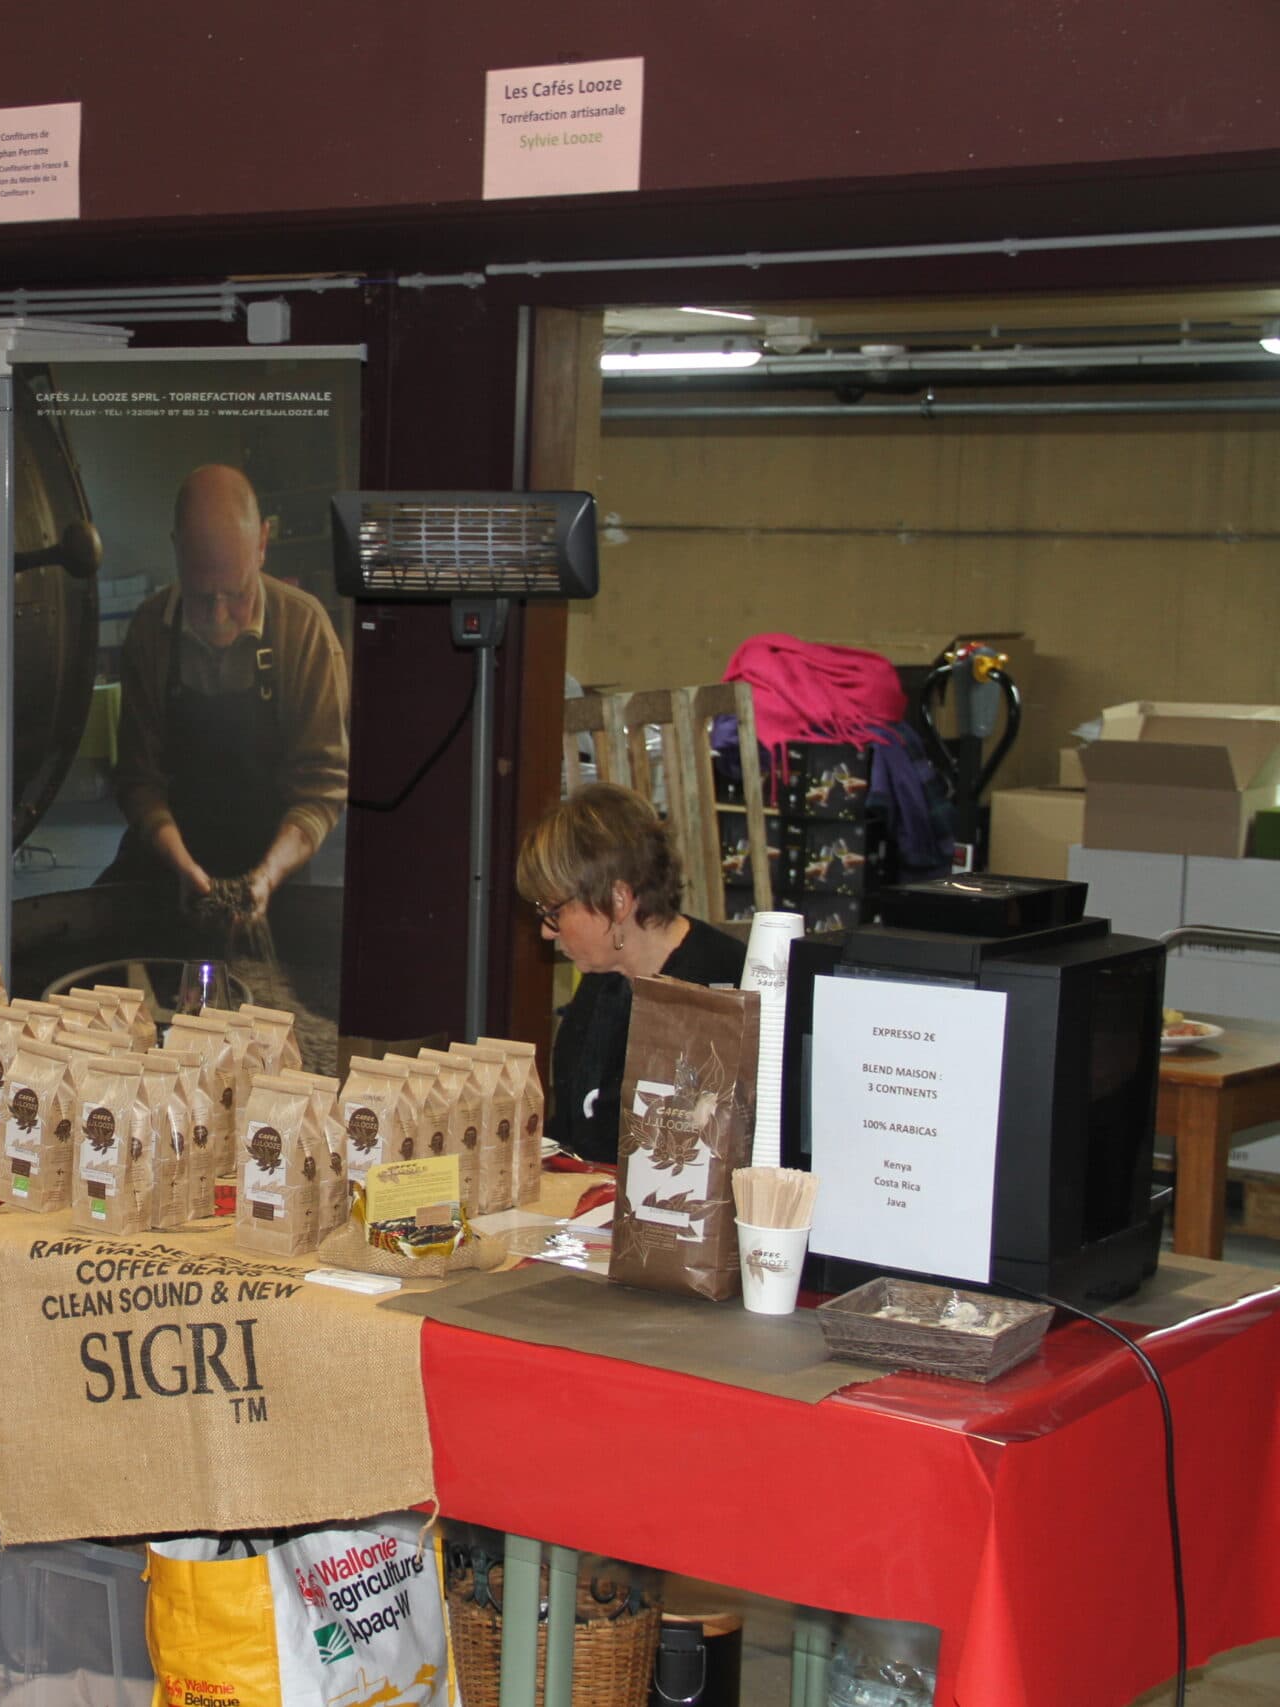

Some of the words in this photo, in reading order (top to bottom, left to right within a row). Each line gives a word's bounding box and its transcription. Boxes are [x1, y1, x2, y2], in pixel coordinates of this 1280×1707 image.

[504, 84, 528, 100] Les
[532, 80, 574, 98] Cafés
[579, 78, 623, 94] Looze
[500, 109, 568, 125] Torréfaction
[570, 103, 626, 120] artisanale
[519, 132, 560, 152] Sylvie
[563, 130, 603, 146] Looze
[92, 392, 129, 402] LOOZE
[131, 392, 160, 402] SPRL
[169, 391, 255, 402] TORREFACTION
[258, 391, 332, 401] ARTISANALE
[872, 1026, 921, 1041] EXPRESSO
[923, 1031, 936, 1042] 2€
[862, 1063, 893, 1076] BLEND
[895, 1067, 937, 1080] MAISON
[867, 1082, 874, 1092] 3
[875, 1083, 938, 1100] CONTINENTS
[862, 1119, 887, 1131] 100%
[889, 1122, 937, 1137] ARABICAS
[883, 1160, 912, 1173] Kenya
[874, 1176, 899, 1189] Costa
[901, 1180, 921, 1192] Rica
[886, 1197, 907, 1209] Java
[30, 1240, 92, 1260] RAW
[76, 1259, 171, 1285] COFFEE
[177, 1262, 262, 1278] BEANS
[41, 1290, 114, 1321] CLEAN
[120, 1282, 203, 1314] SOUND
[210, 1280, 229, 1304] &
[237, 1281, 304, 1302] NEW
[79, 1317, 264, 1404] SIGRI
[230, 1396, 269, 1424] TM
[314, 1535, 398, 1587] Wallonie
[328, 1554, 424, 1613] agriculture
[345, 1589, 410, 1644] Apaq-W
[184, 1679, 235, 1695] Wallonie
[184, 1692, 240, 1707] Belgique
